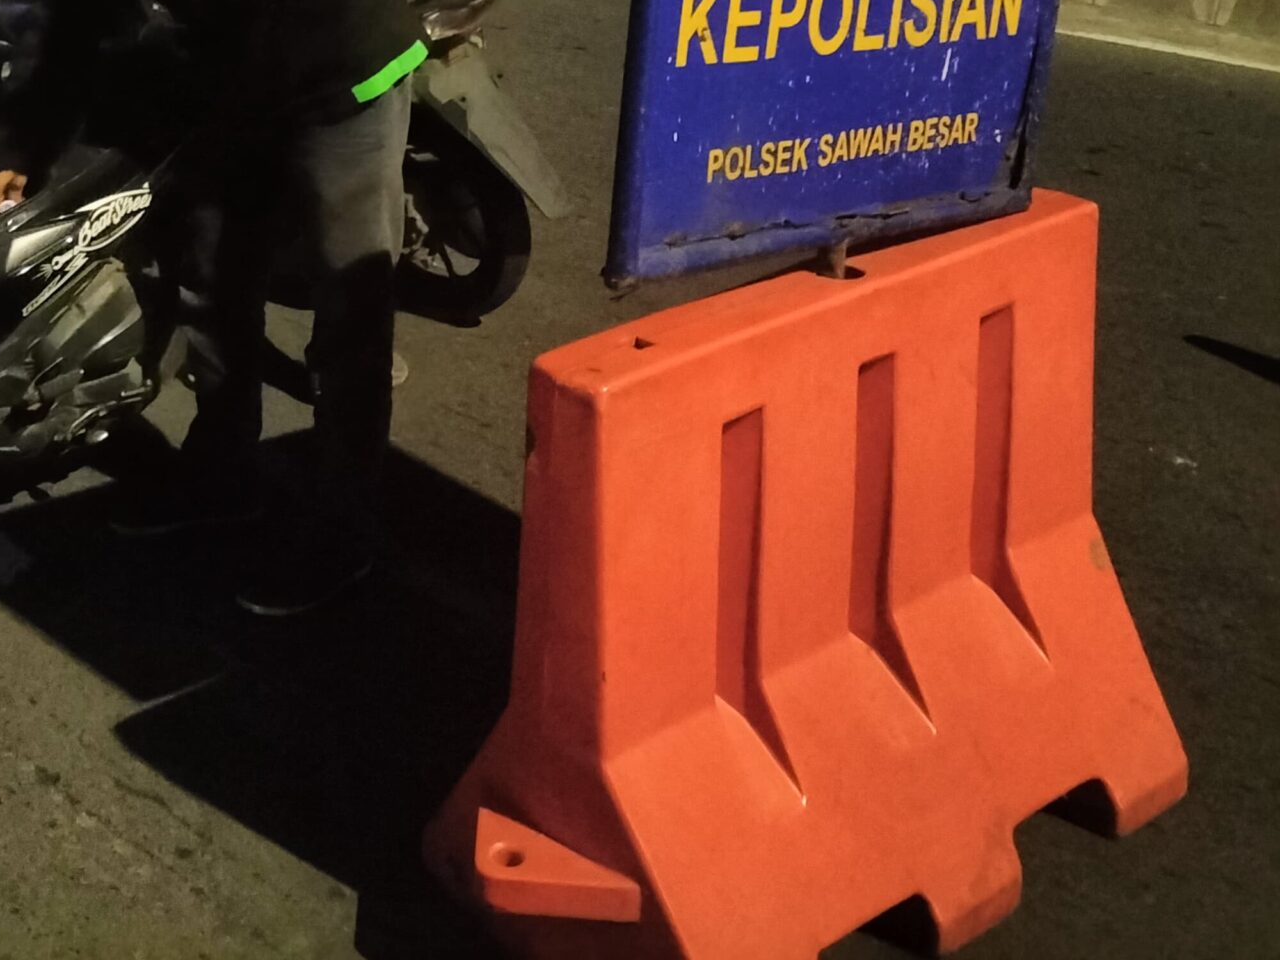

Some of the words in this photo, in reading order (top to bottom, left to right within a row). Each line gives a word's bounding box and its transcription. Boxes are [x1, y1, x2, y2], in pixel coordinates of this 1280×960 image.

[706, 137, 810, 183] POLSEK
[818, 122, 904, 165] SAWAH
[906, 112, 980, 151] BESAR
